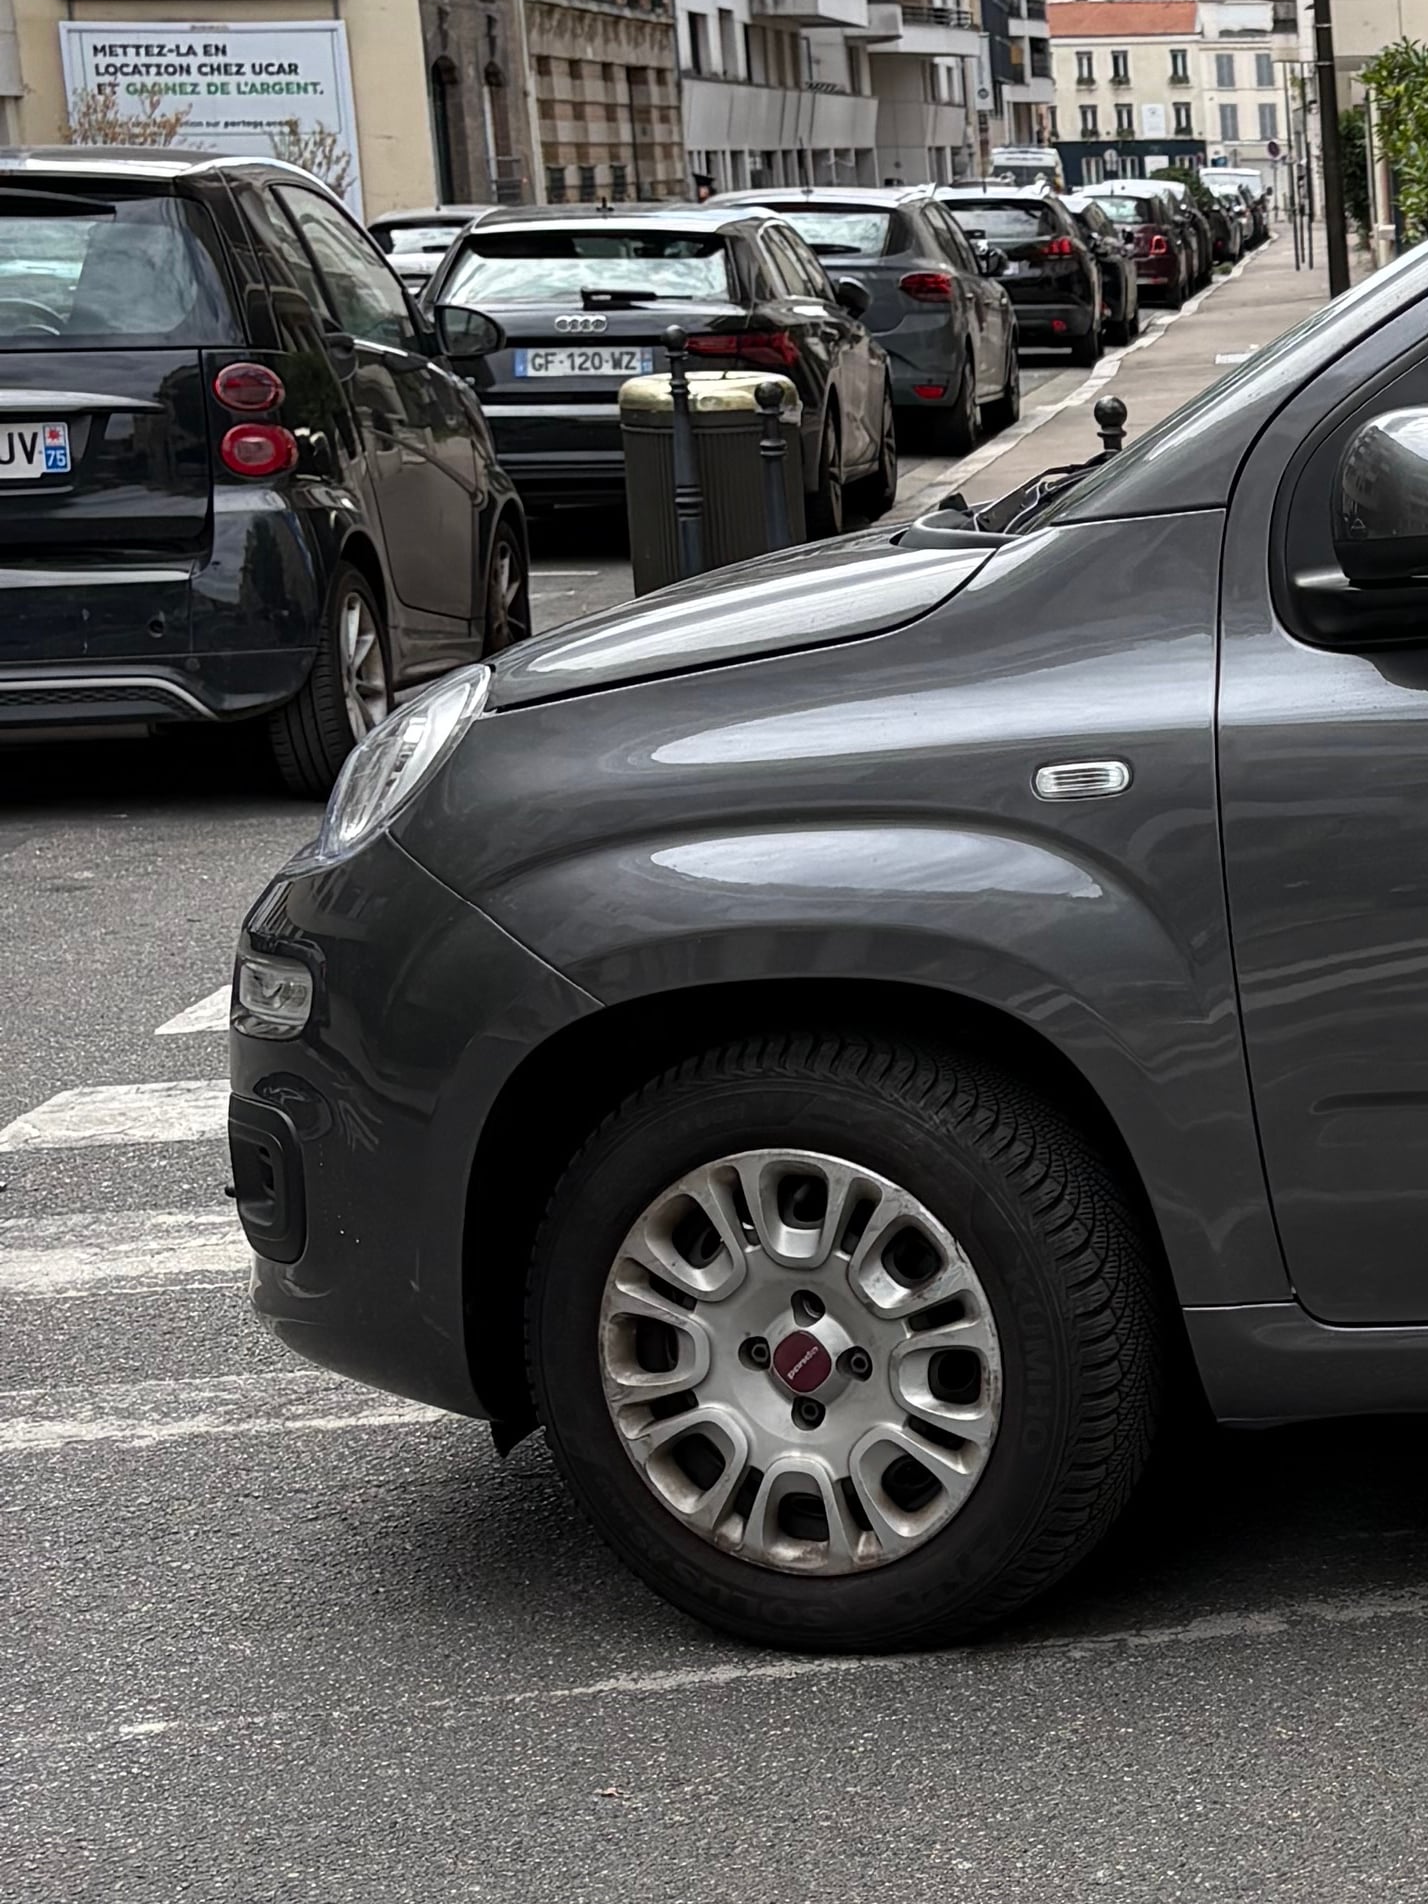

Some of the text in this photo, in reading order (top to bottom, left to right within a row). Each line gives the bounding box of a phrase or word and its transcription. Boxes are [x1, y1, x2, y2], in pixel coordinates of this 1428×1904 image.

[93, 44, 228, 58] METTEZ-LA EN
[95, 62, 299, 76] LOCATION CHEZ UCAR
[97, 81, 324, 96] ET GAGNEZ DE L'ARGENT.
[46, 449, 66, 467] 75
